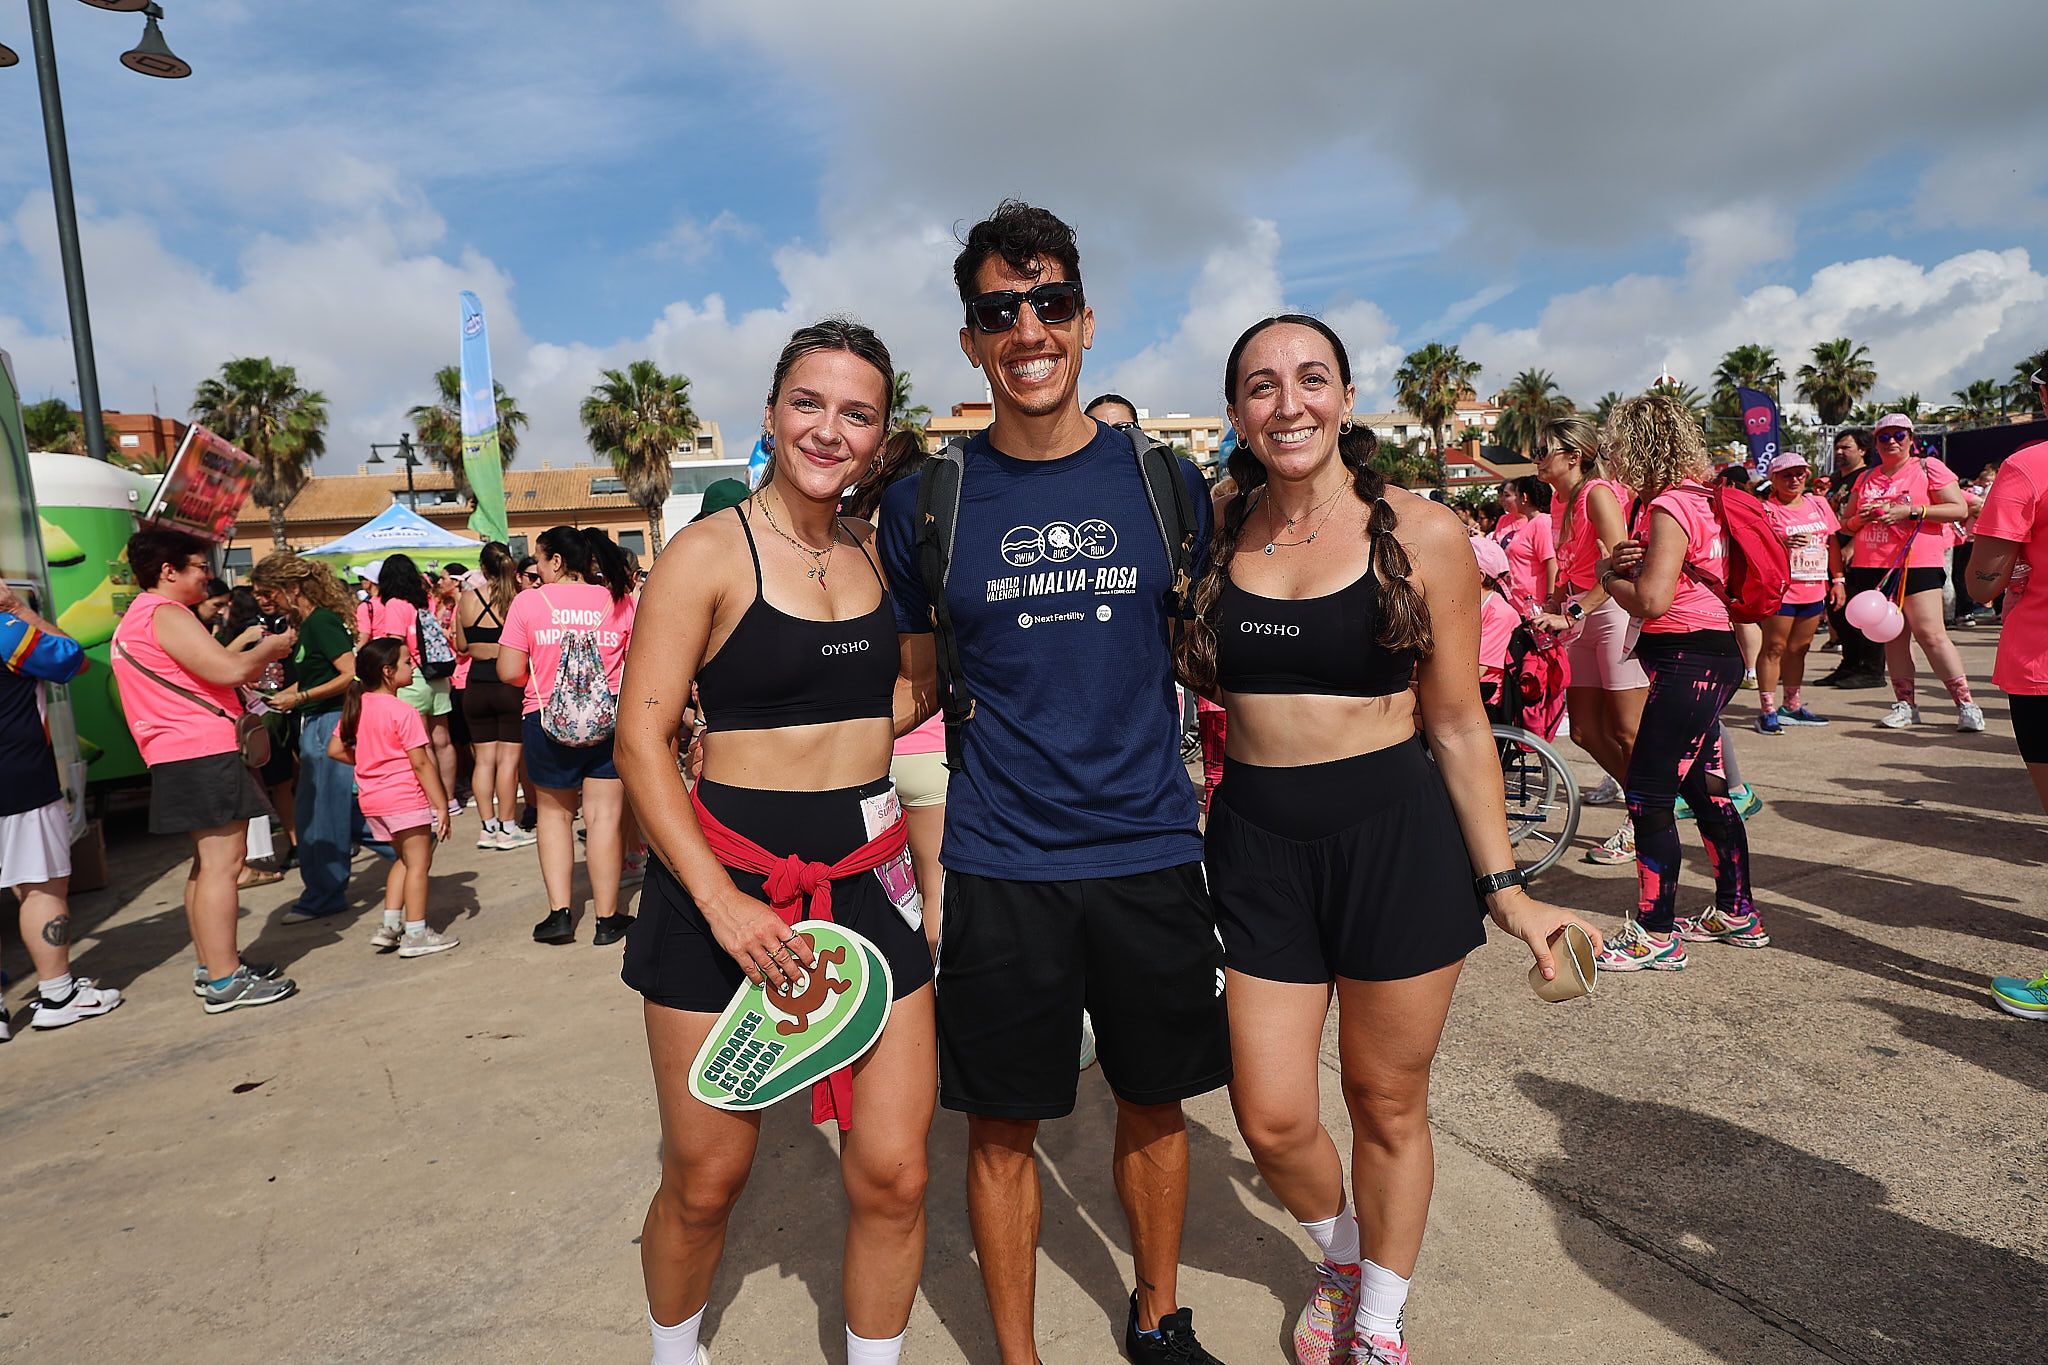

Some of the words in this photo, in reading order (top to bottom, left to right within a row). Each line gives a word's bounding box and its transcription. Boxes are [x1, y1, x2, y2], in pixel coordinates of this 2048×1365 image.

[1014, 551, 1035, 564] SWIM
[1052, 548, 1069, 559] BIKE
[1090, 545, 1105, 556] RUN
[986, 576, 1020, 592] TRIATLO
[1028, 566, 1138, 597] MALVA-ROSA
[986, 587, 1020, 603] VALENCIA
[551, 608, 602, 626] SOMOS
[1034, 614, 1054, 624] Next
[1054, 611, 1085, 621] Fertility
[1240, 621, 1300, 637] OYSHO
[821, 639, 870, 656] OYSHO
[703, 1011, 763, 1082] CUIDARSE
[718, 1071, 740, 1092] ES
[732, 1039, 766, 1072] UNA
[734, 1041, 785, 1100] GOZADA
